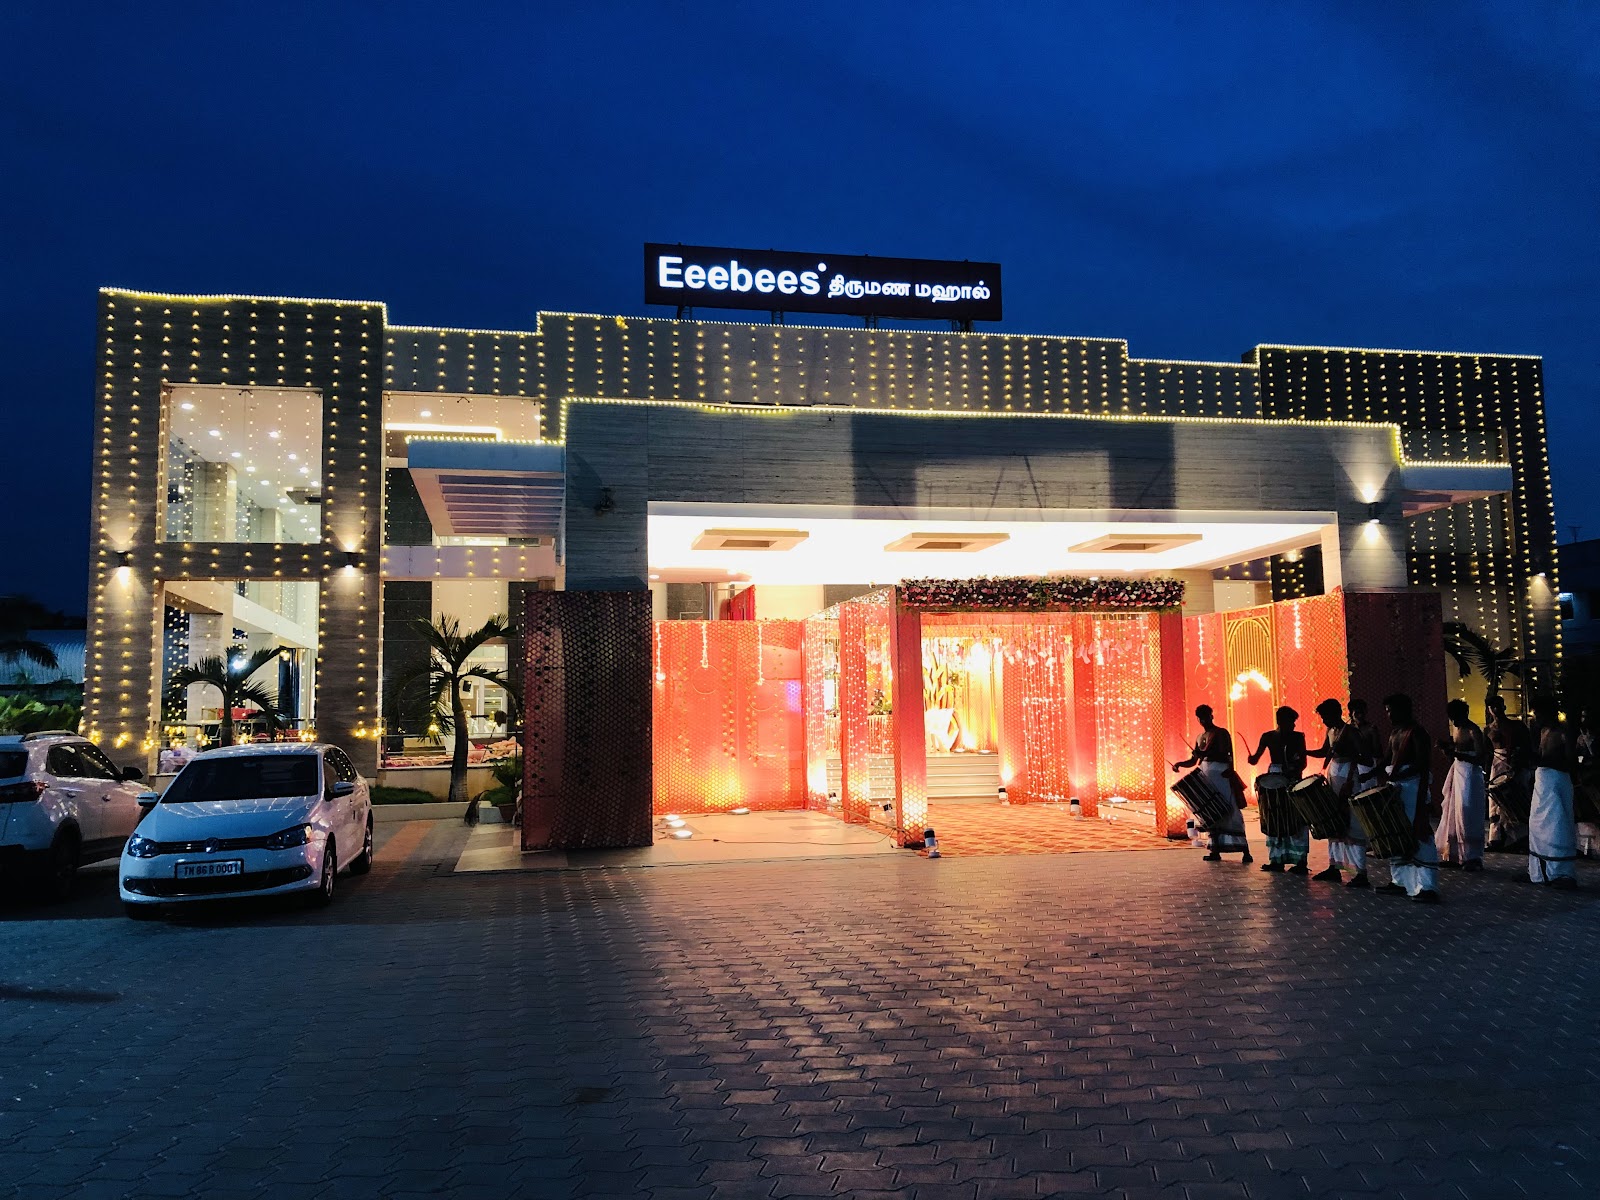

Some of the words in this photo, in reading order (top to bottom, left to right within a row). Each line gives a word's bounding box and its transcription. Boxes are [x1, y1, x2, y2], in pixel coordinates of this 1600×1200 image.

[658, 256, 821, 295] Eeebees
[828, 274, 911, 298] திருமண
[914, 280, 991, 302] மஹால்
[216, 863, 238, 873] 0001
